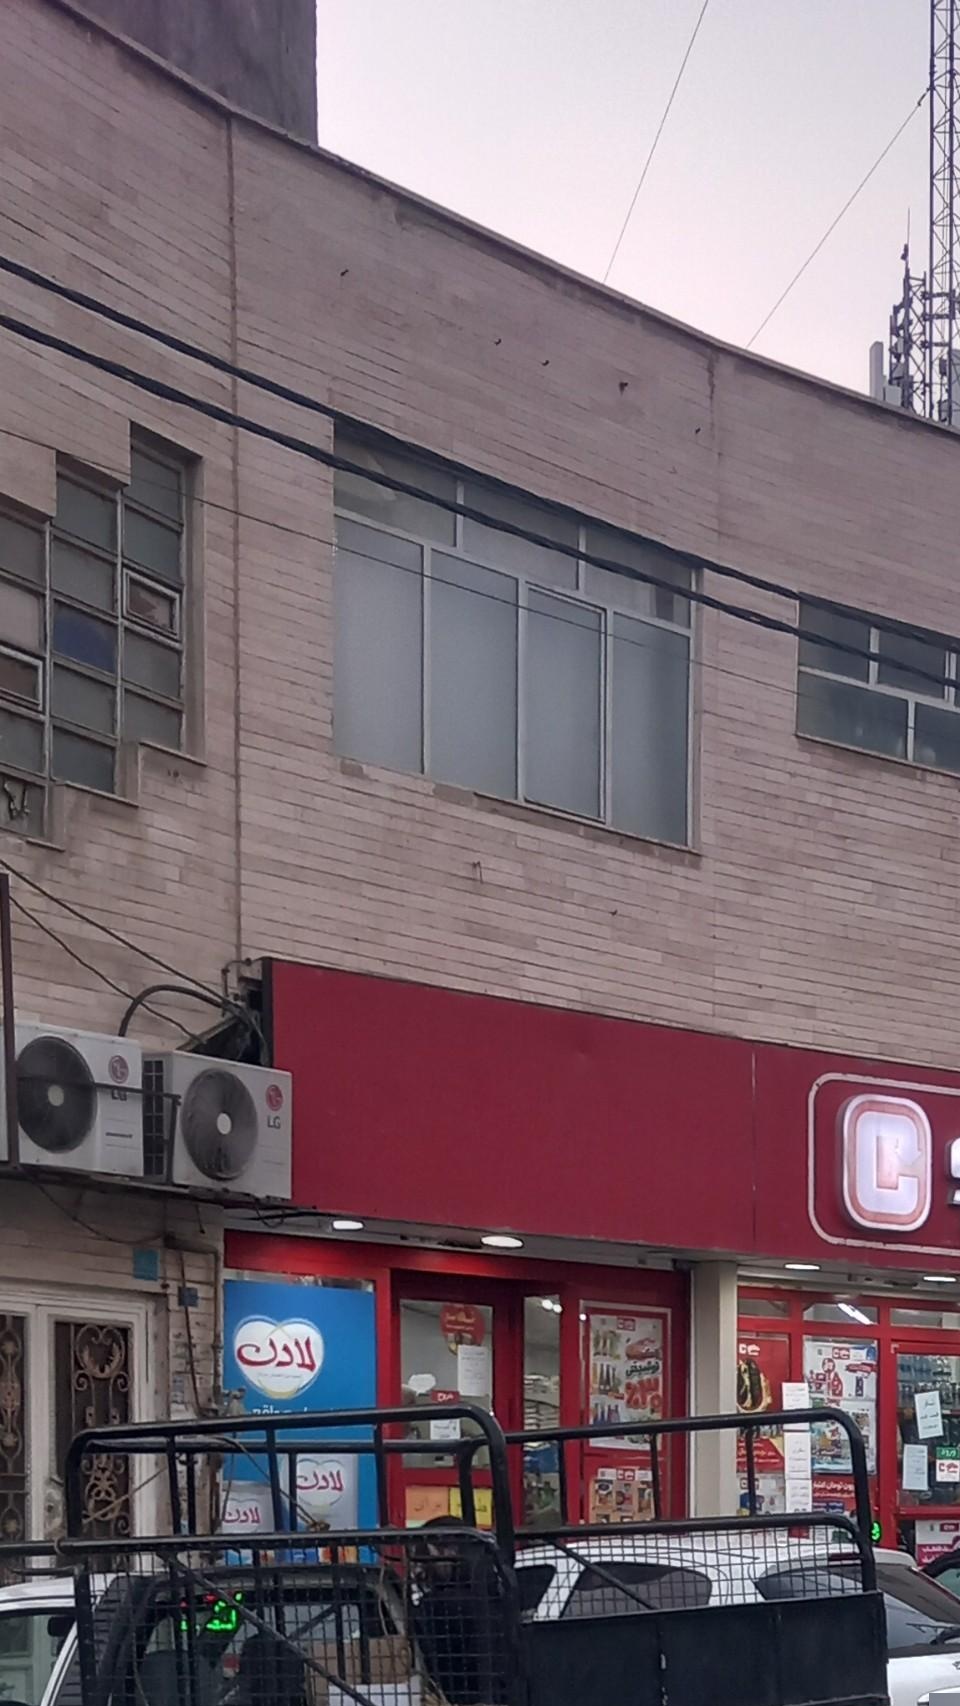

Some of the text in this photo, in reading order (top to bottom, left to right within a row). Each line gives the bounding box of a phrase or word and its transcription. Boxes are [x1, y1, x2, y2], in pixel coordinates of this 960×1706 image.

[267, 1115, 281, 1129] LG
[236, 1336, 317, 1373] لادن
[296, 1469, 344, 1492] لادن
[223, 1506, 261, 1524] لادن
